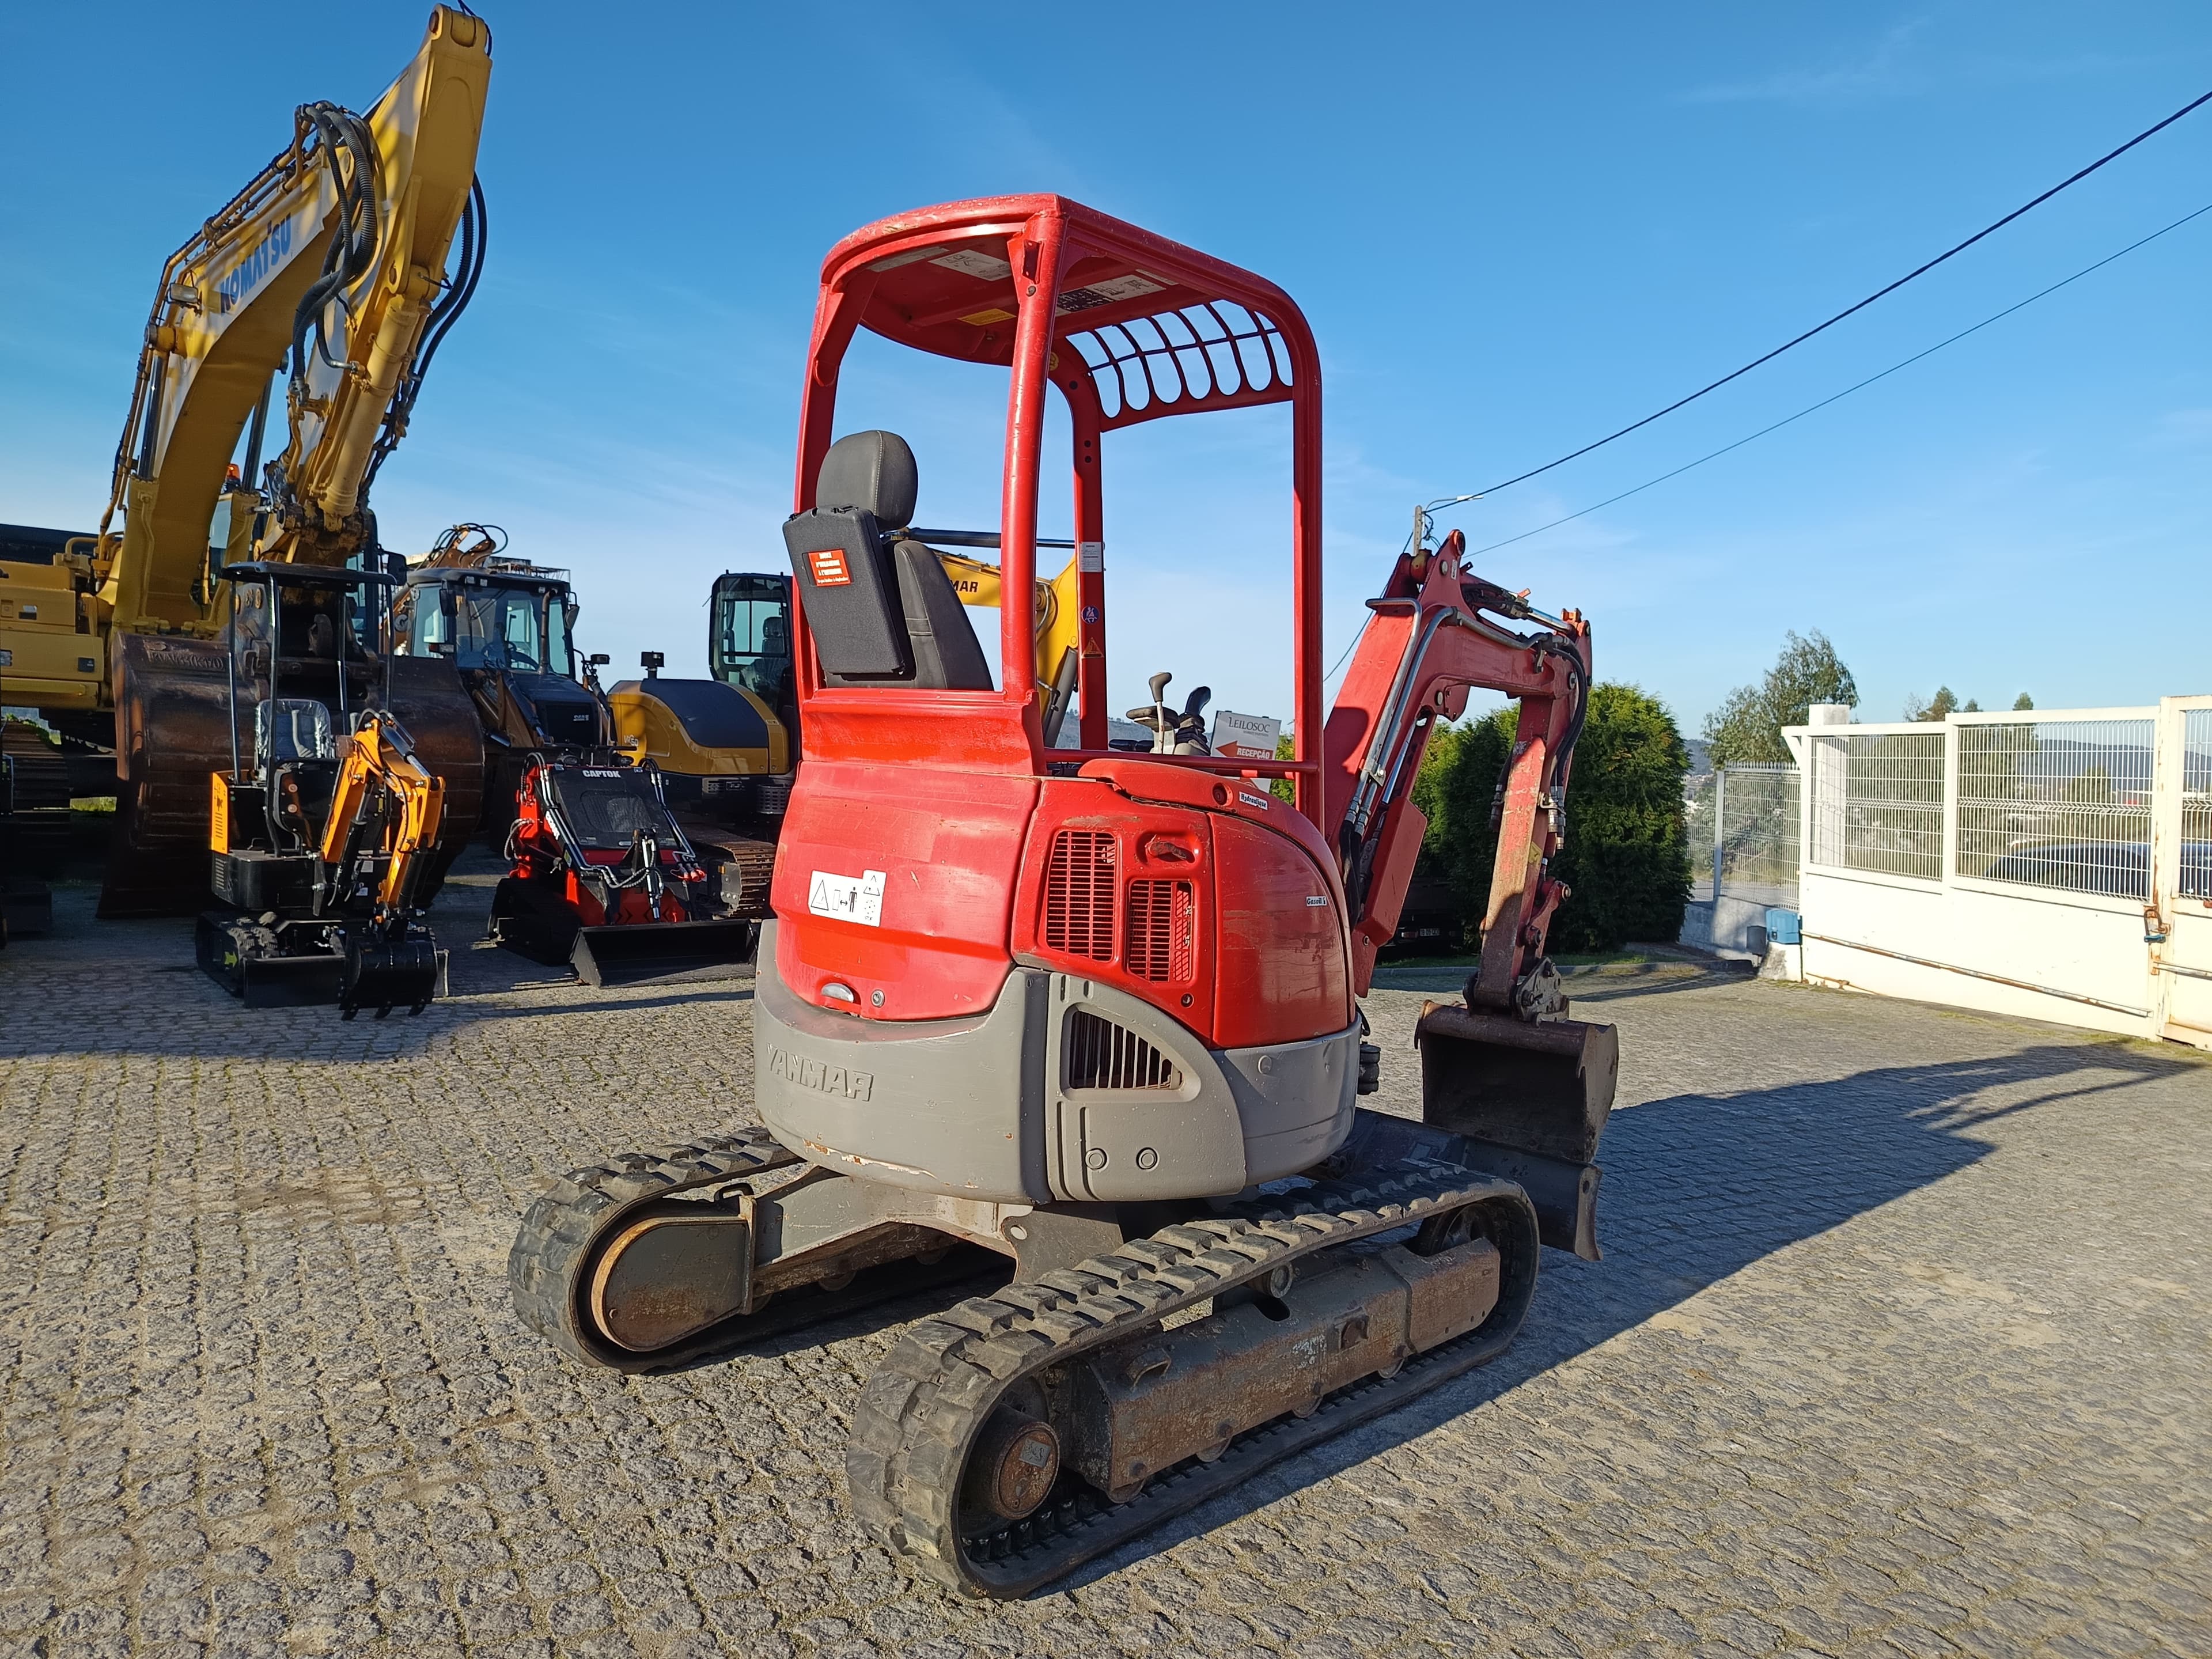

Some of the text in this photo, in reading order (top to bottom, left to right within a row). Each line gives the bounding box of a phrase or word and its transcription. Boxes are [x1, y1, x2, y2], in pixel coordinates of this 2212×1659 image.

[220, 213, 291, 313] KOMATSU
[1229, 717, 1271, 733] LEILOSOC
[1237, 748, 1270, 759] RECEPÇÃO
[582, 770, 621, 778] CAPTOK
[766, 1043, 874, 1101] YANMAR
